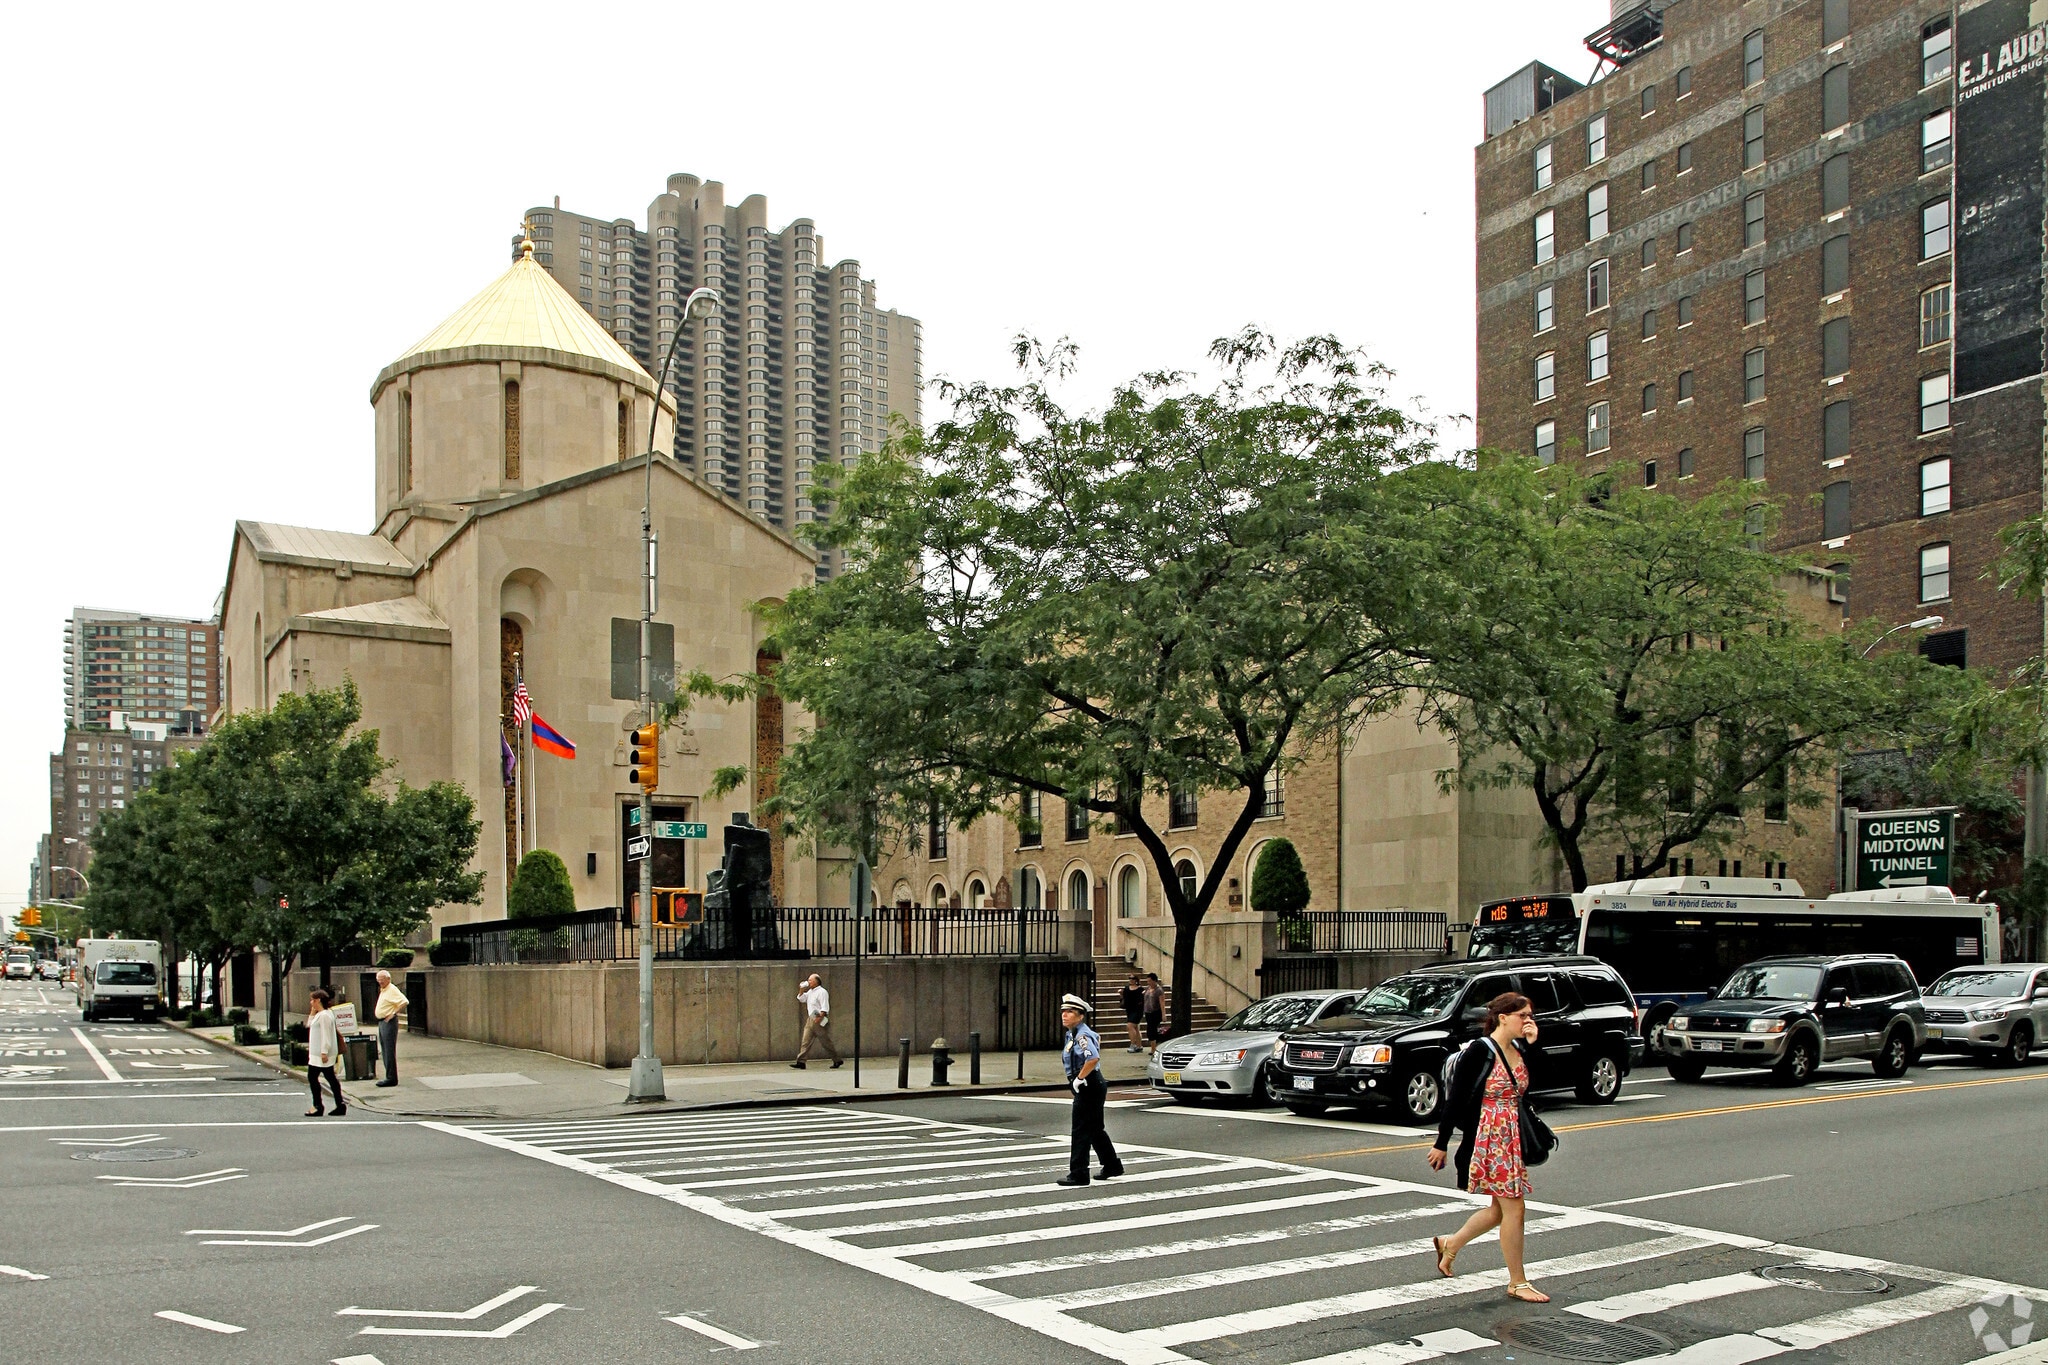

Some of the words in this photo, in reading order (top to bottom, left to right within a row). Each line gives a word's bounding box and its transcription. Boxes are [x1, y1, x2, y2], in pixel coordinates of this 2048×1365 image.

[666, 824, 674, 836] E
[679, 824, 696, 837] 34
[1868, 819, 1940, 836] QUEENS
[1863, 837, 1945, 854] MIDTOWN
[1869, 856, 1937, 872] TUNNEL
[1667, 899, 1677, 907] Air
[1678, 899, 1700, 909] Hybrid
[1701, 900, 1724, 909] Electric
[1725, 900, 1738, 909] Bus
[1491, 905, 1508, 921] M16
[108, 1048, 213, 1057] ONLY
[1301, 1050, 1325, 1059] GMC
